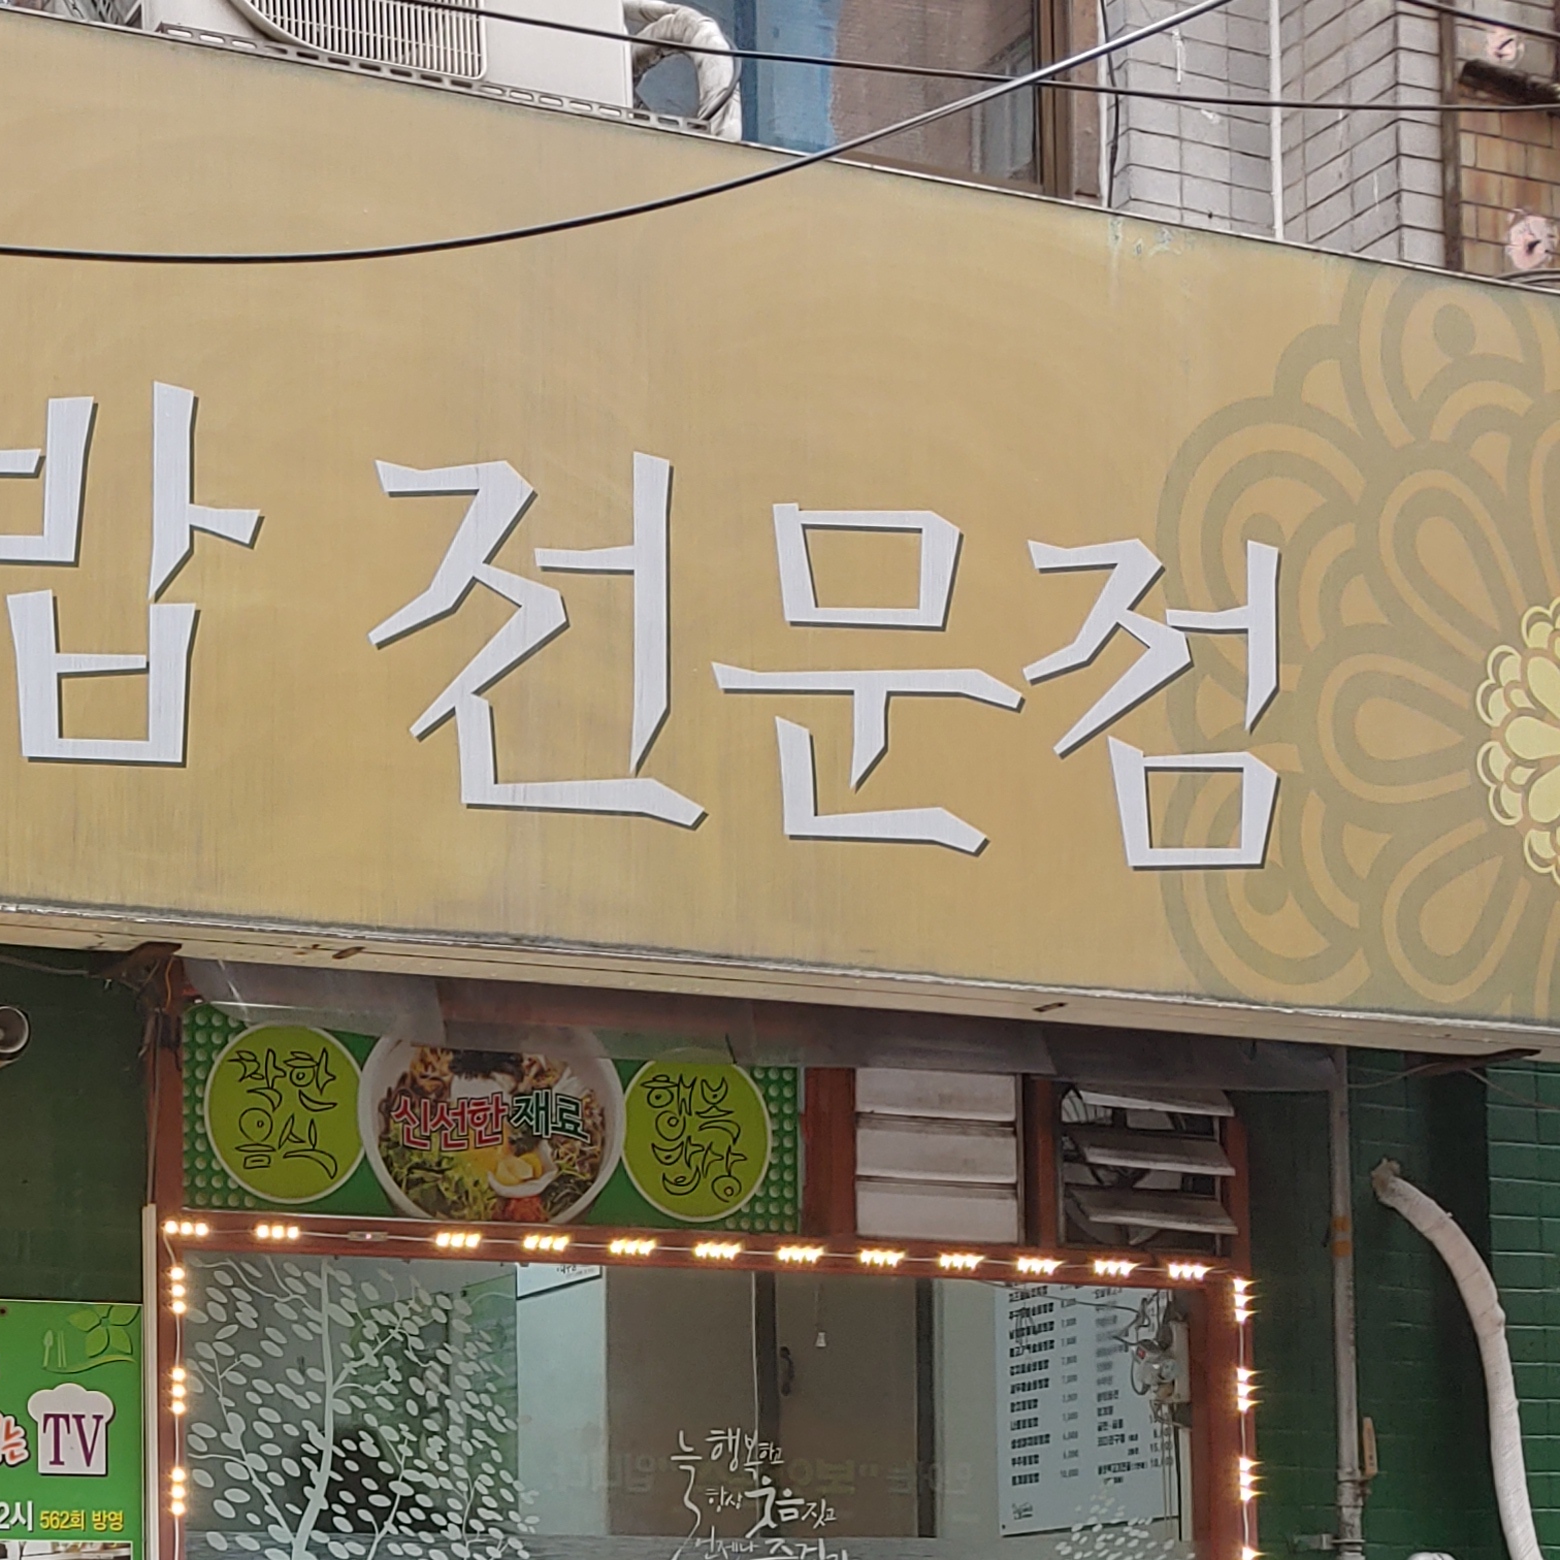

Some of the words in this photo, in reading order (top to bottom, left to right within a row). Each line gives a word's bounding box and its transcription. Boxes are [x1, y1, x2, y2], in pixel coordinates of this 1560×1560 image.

[367, 450, 1282, 872] 전문점
[392, 1091, 507, 1152] 신선한
[510, 1088, 591, 1143] 재료
[42, 1413, 104, 1468] TV
[705, 1428, 785, 1482] 행복하고
[40, 1509, 86, 1531] 562회
[91, 1509, 125, 1531] 방영
[705, 1486, 744, 1514] 항상
[695, 1525, 760, 1560] 언제나
